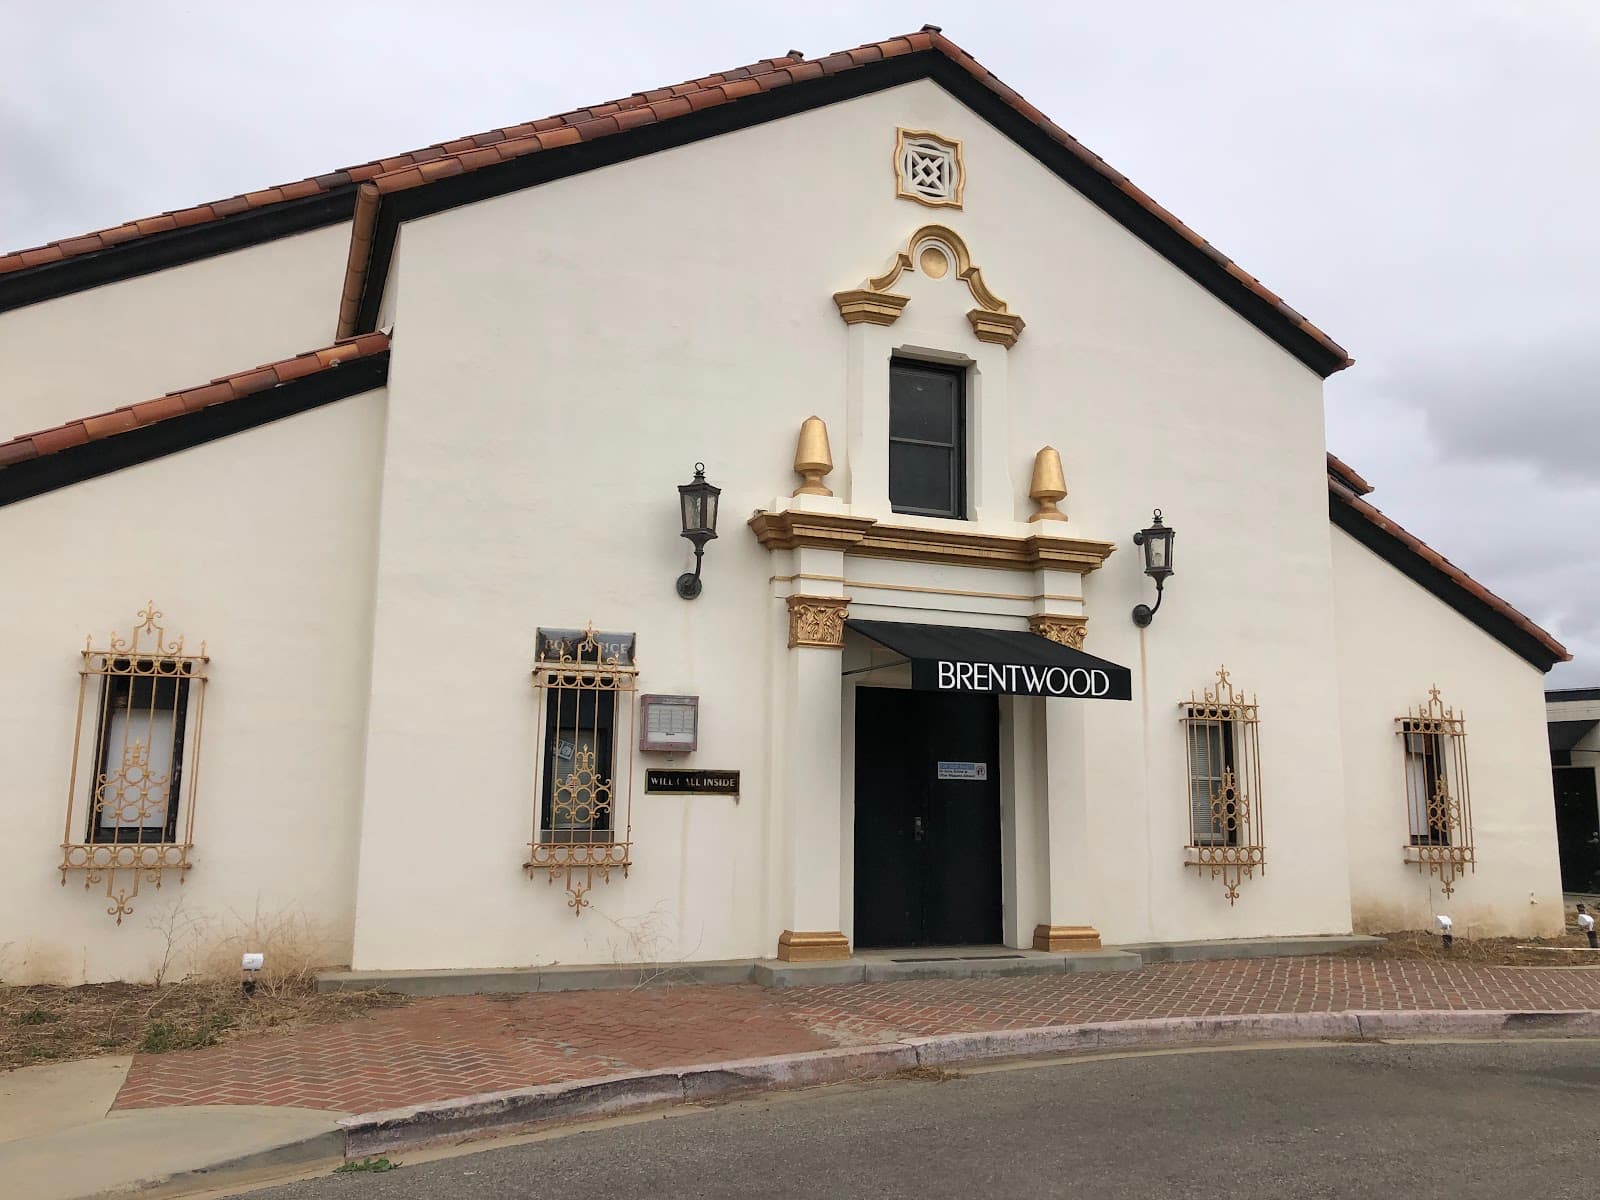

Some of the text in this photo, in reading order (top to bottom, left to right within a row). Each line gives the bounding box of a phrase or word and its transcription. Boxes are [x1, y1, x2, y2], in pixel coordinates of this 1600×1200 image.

[544, 639, 628, 655] BOX OICE
[938, 661, 1110, 696] BRENTWOOD
[650, 777, 673, 786] WILL
[703, 778, 736, 787] INSIDE
